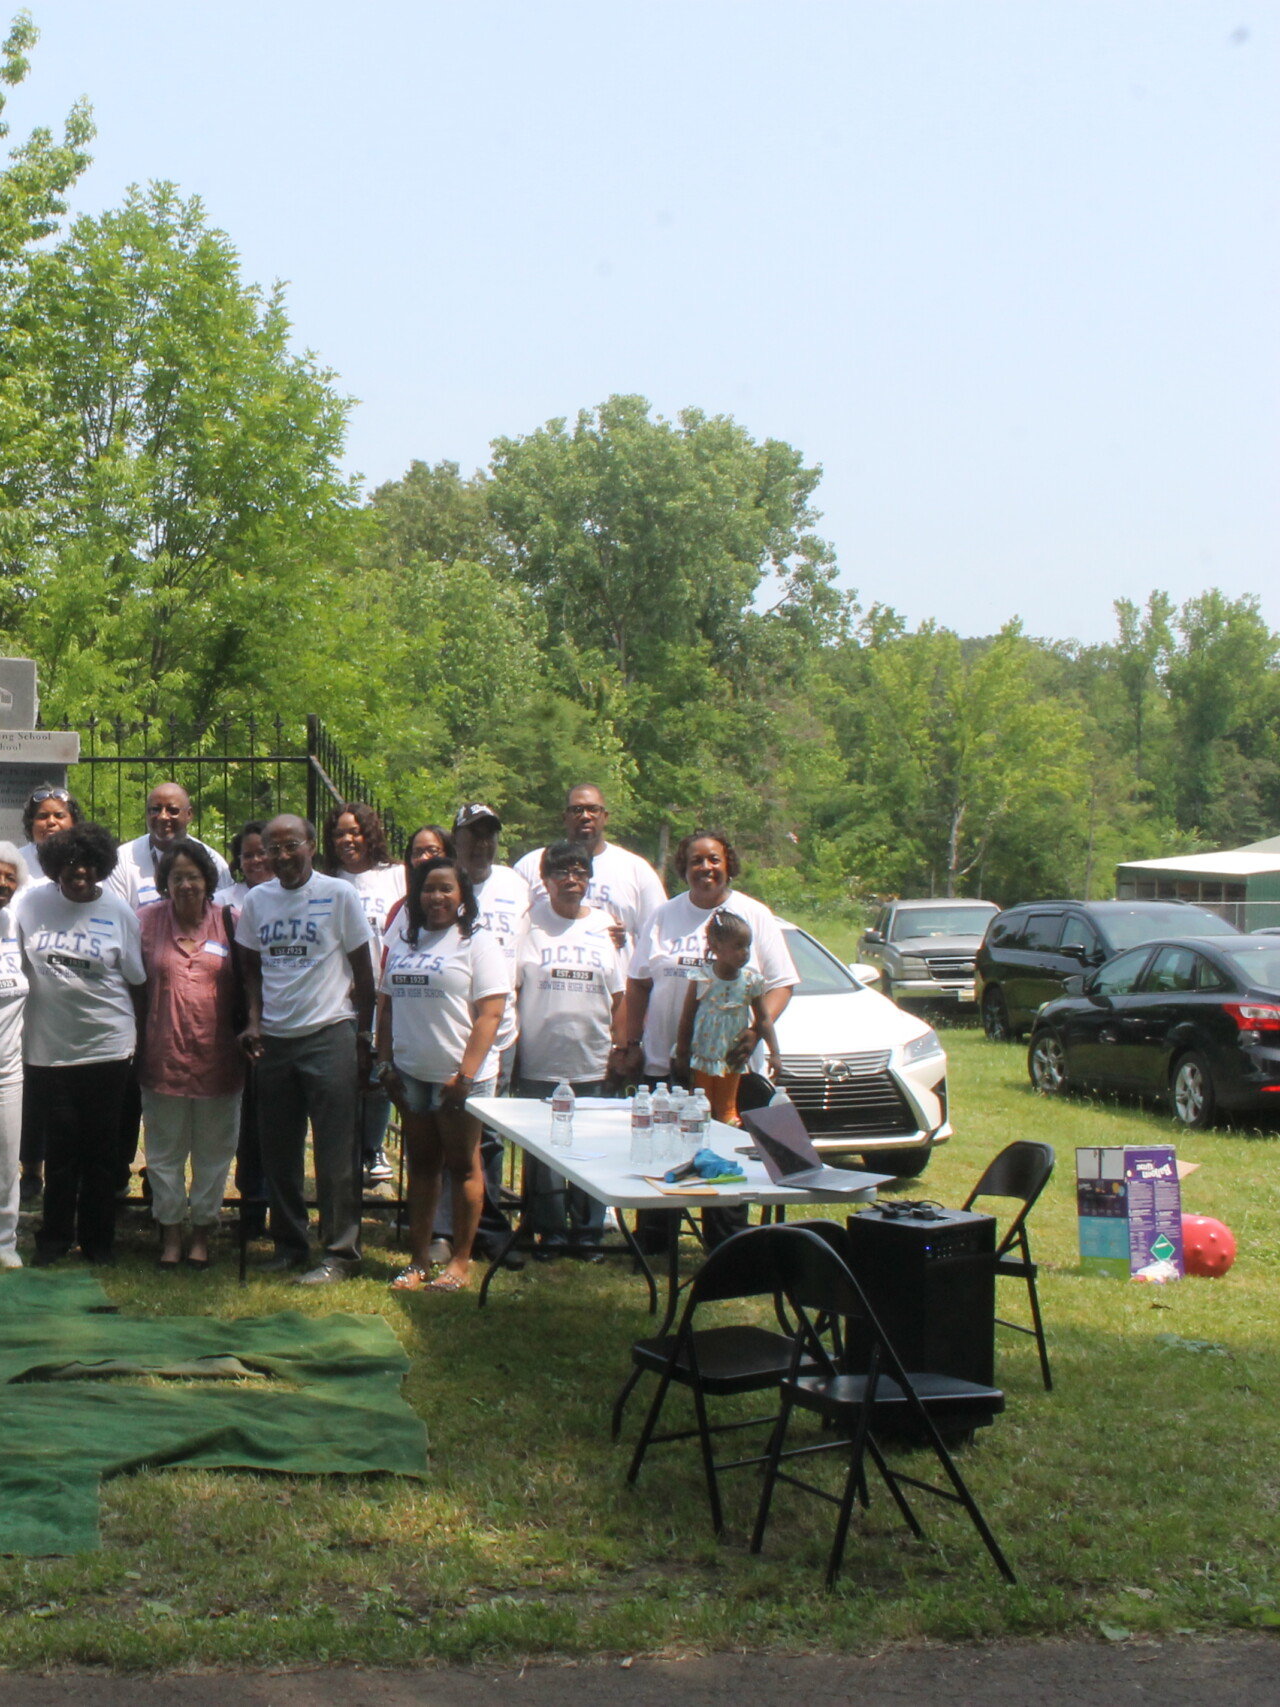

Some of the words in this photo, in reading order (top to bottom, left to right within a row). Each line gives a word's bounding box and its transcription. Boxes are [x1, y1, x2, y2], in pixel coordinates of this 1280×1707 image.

[18, 732, 51, 741] School
[260, 918, 321, 946] D.C.T.S.
[36, 931, 104, 961] D.C.T.S.
[286, 947, 303, 956] 1925
[540, 945, 605, 972] D.C.T.S.
[395, 975, 409, 984] EST.
[409, 975, 425, 984] 1925
[556, 970, 571, 978] EST.
[572, 971, 589, 980] 1925
[0, 980, 14, 988] 1925
